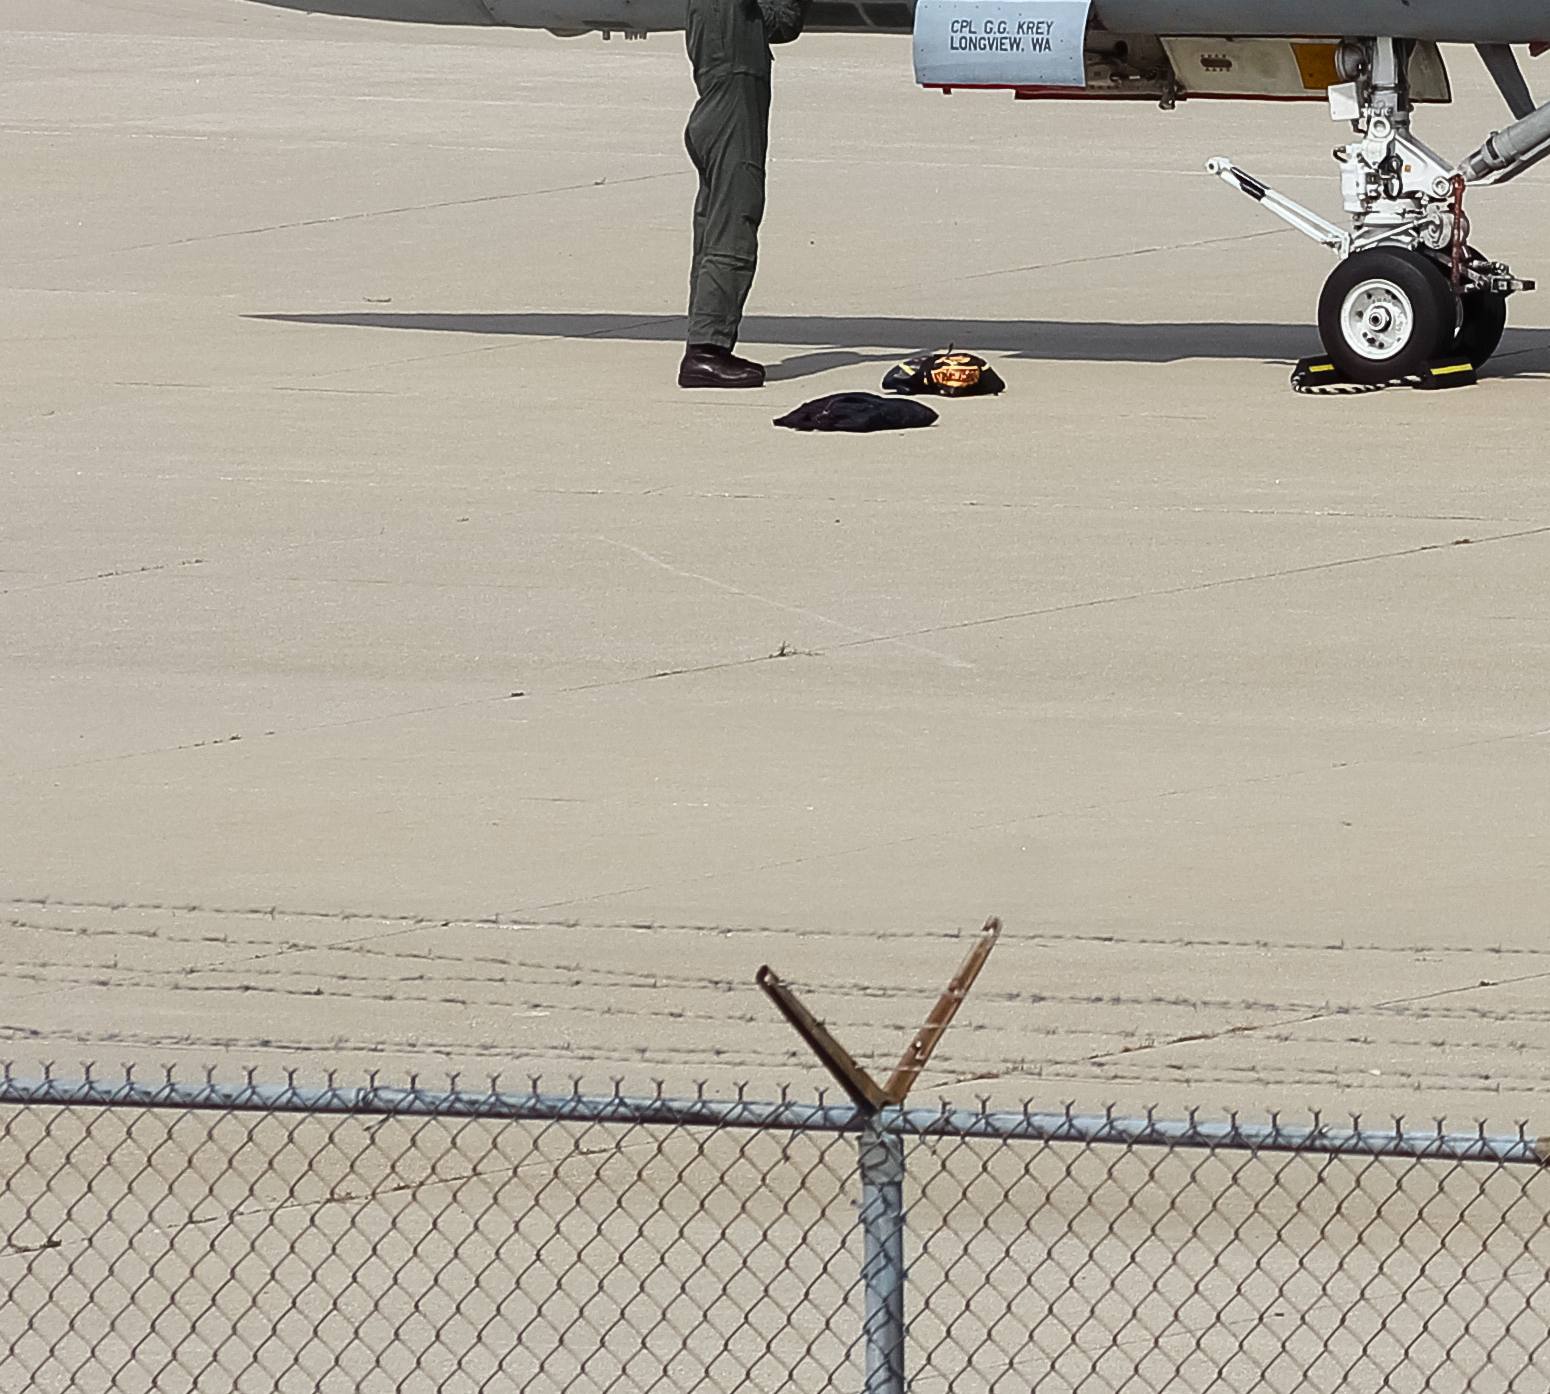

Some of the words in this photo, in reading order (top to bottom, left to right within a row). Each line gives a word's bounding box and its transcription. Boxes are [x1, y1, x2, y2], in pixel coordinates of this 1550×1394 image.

[950, 19, 977, 34] CPL
[984, 19, 1010, 35] G.G.
[1016, 20, 1054, 36] KREY
[950, 35, 1025, 52] LONGVIEW,
[1031, 37, 1052, 53] WA
